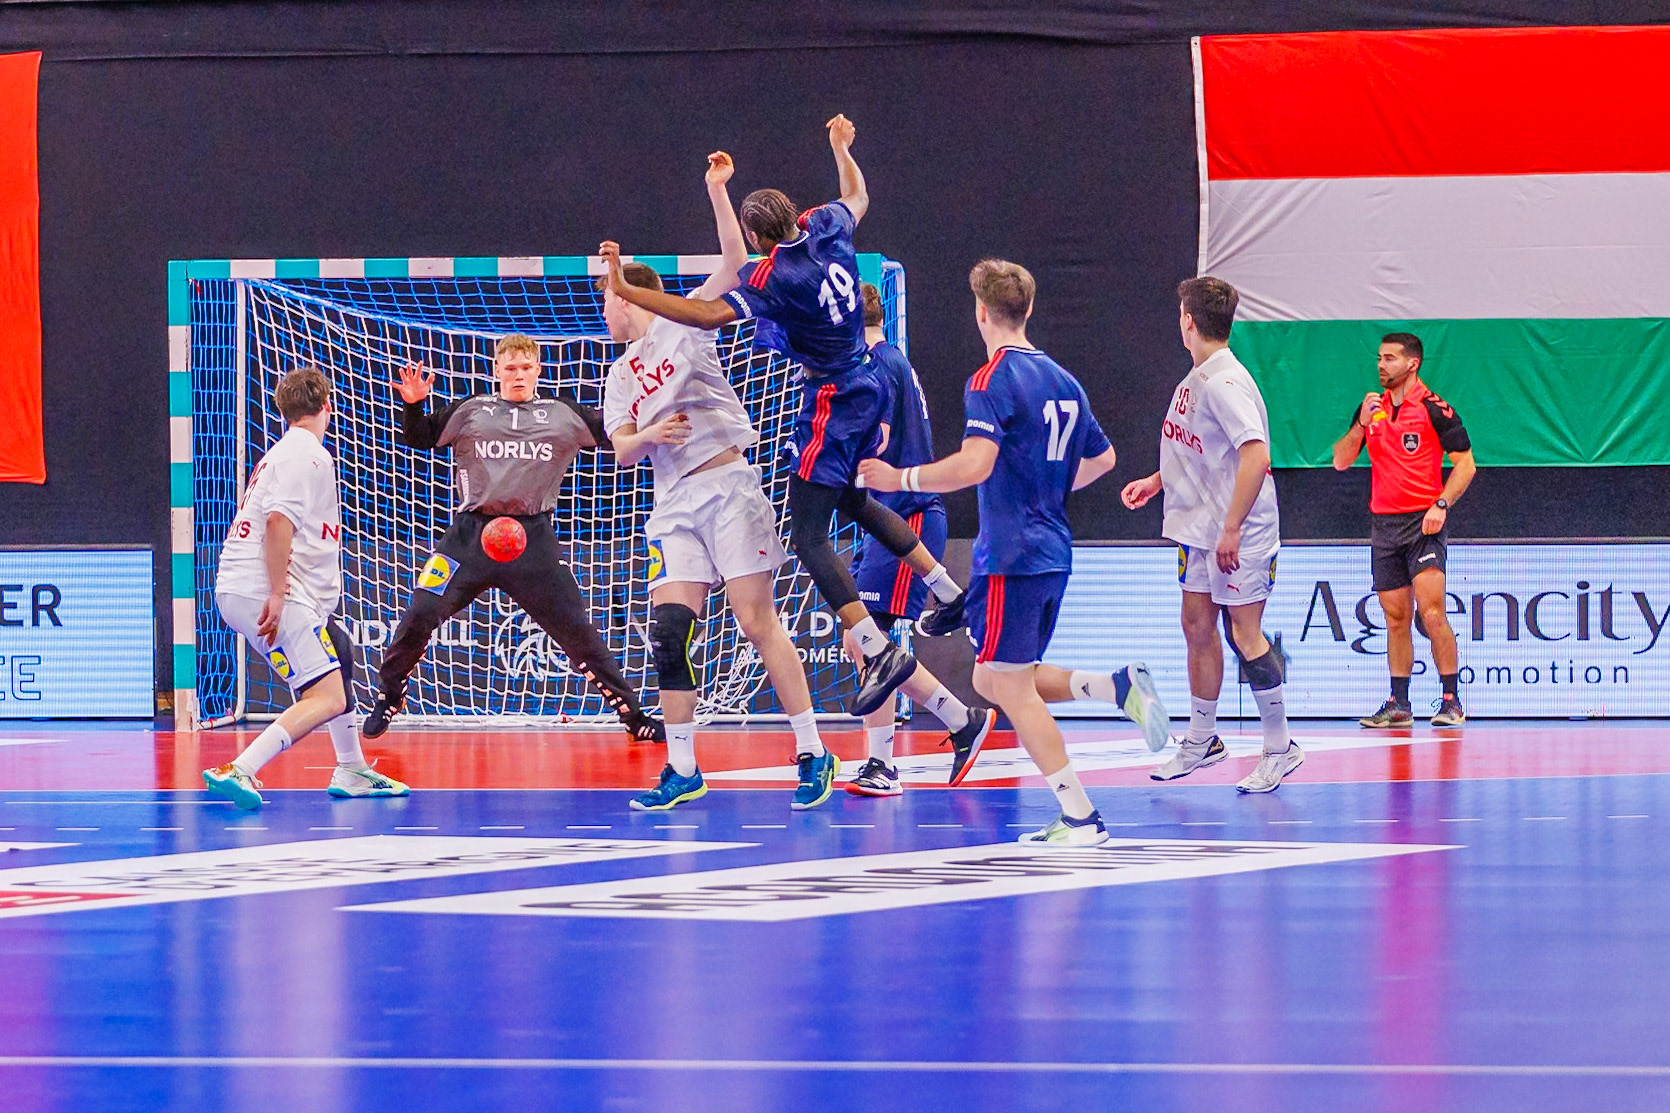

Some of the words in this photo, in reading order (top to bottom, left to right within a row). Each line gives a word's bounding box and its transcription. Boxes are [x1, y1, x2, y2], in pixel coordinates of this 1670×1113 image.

[818, 262, 857, 326] 19
[508, 407, 519, 430] 1
[966, 418, 995, 434] DOMIA
[1042, 399, 1079, 462] 17
[474, 440, 554, 462] NORLYS
[0, 654, 42, 701] E
[1411, 659, 1630, 684] Pomotion
[519, 843, 1319, 912] ACADOMIA
